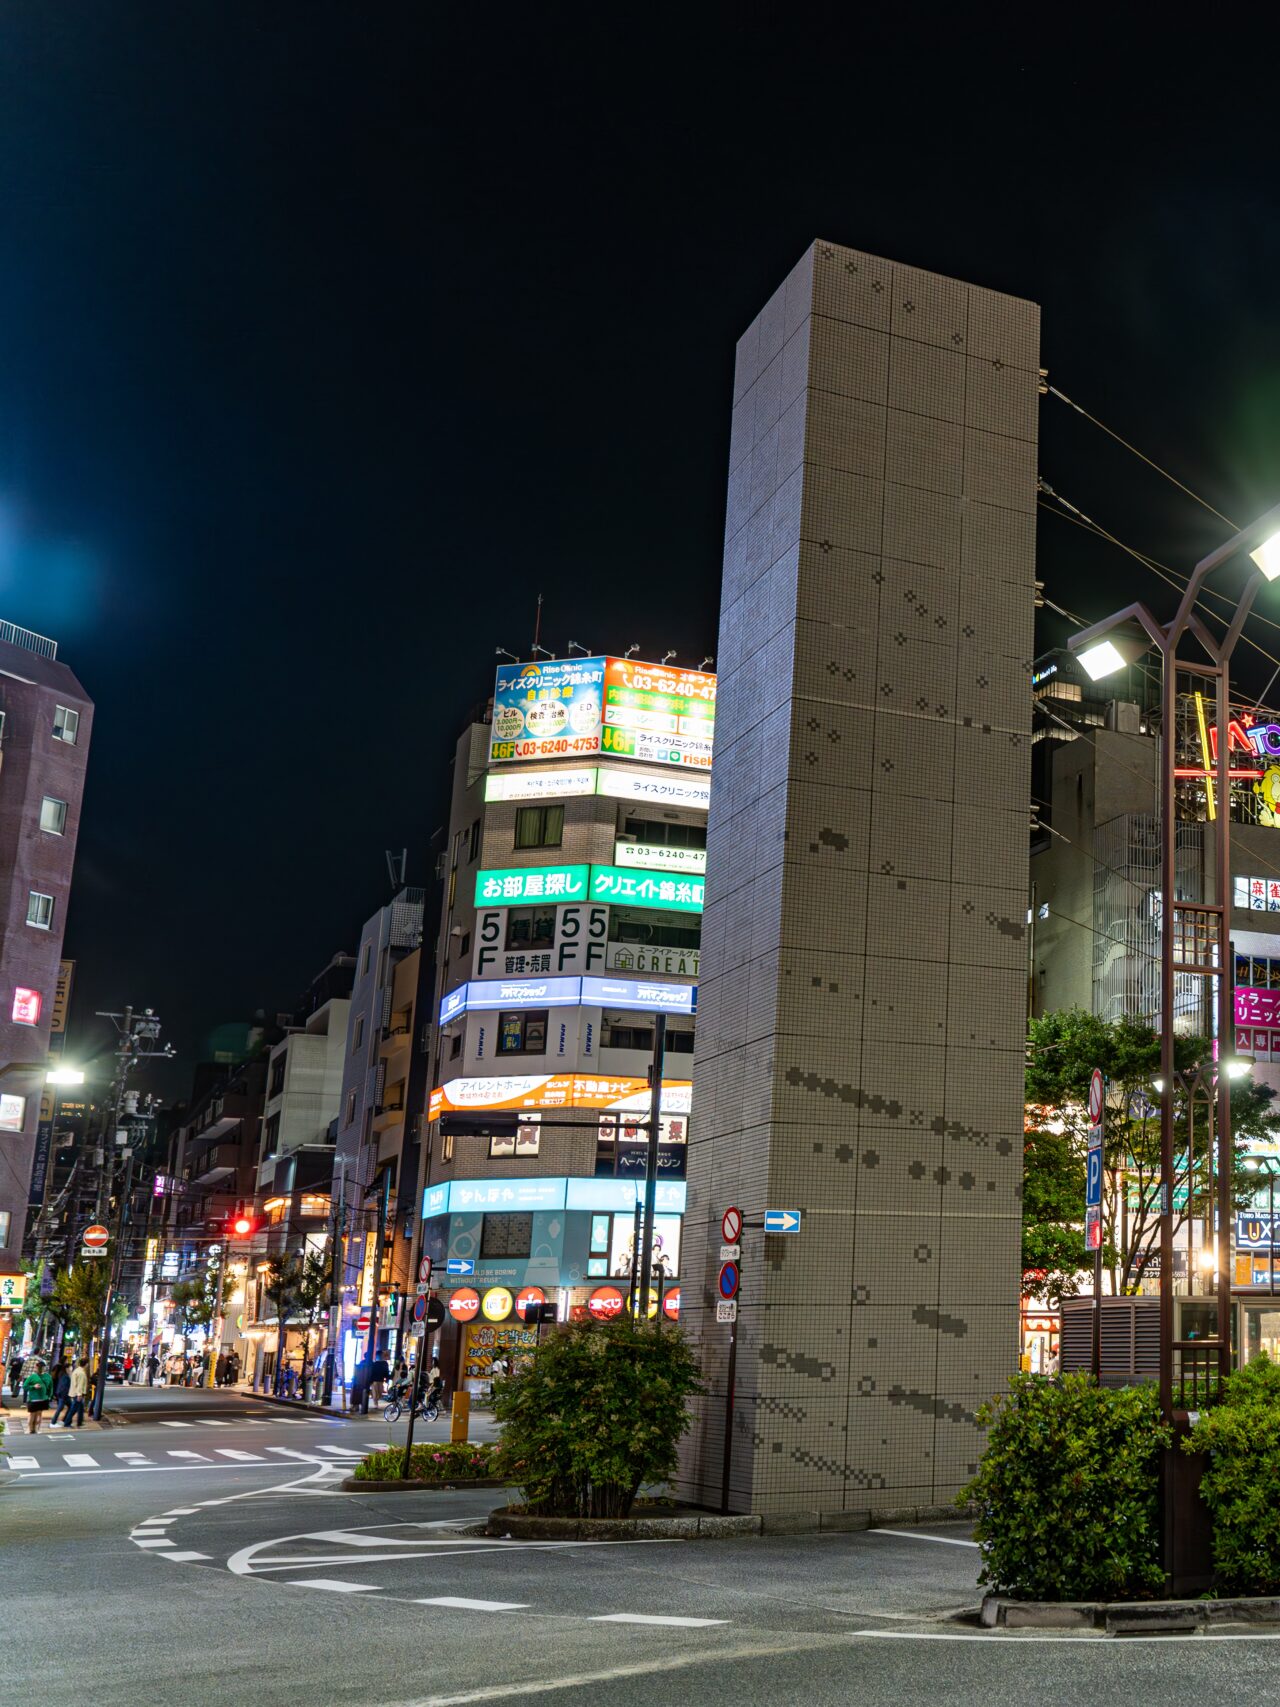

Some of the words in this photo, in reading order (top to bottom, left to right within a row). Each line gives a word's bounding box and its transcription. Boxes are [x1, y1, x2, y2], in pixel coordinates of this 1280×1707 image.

[498, 671, 603, 691] ライズクリニック錦糸町
[523, 737, 599, 754] 03-6240-4753
[612, 730, 634, 752] 6F
[499, 743, 515, 758] 6F
[637, 847, 705, 860] 03-6240-47
[482, 873, 582, 897] お部屋探し
[505, 954, 551, 974] 管理・売買
[460, 1081, 532, 1092] アイレントホーム
[573, 1080, 632, 1093] 不動産ナビ
[1090, 1155, 1098, 1199] P
